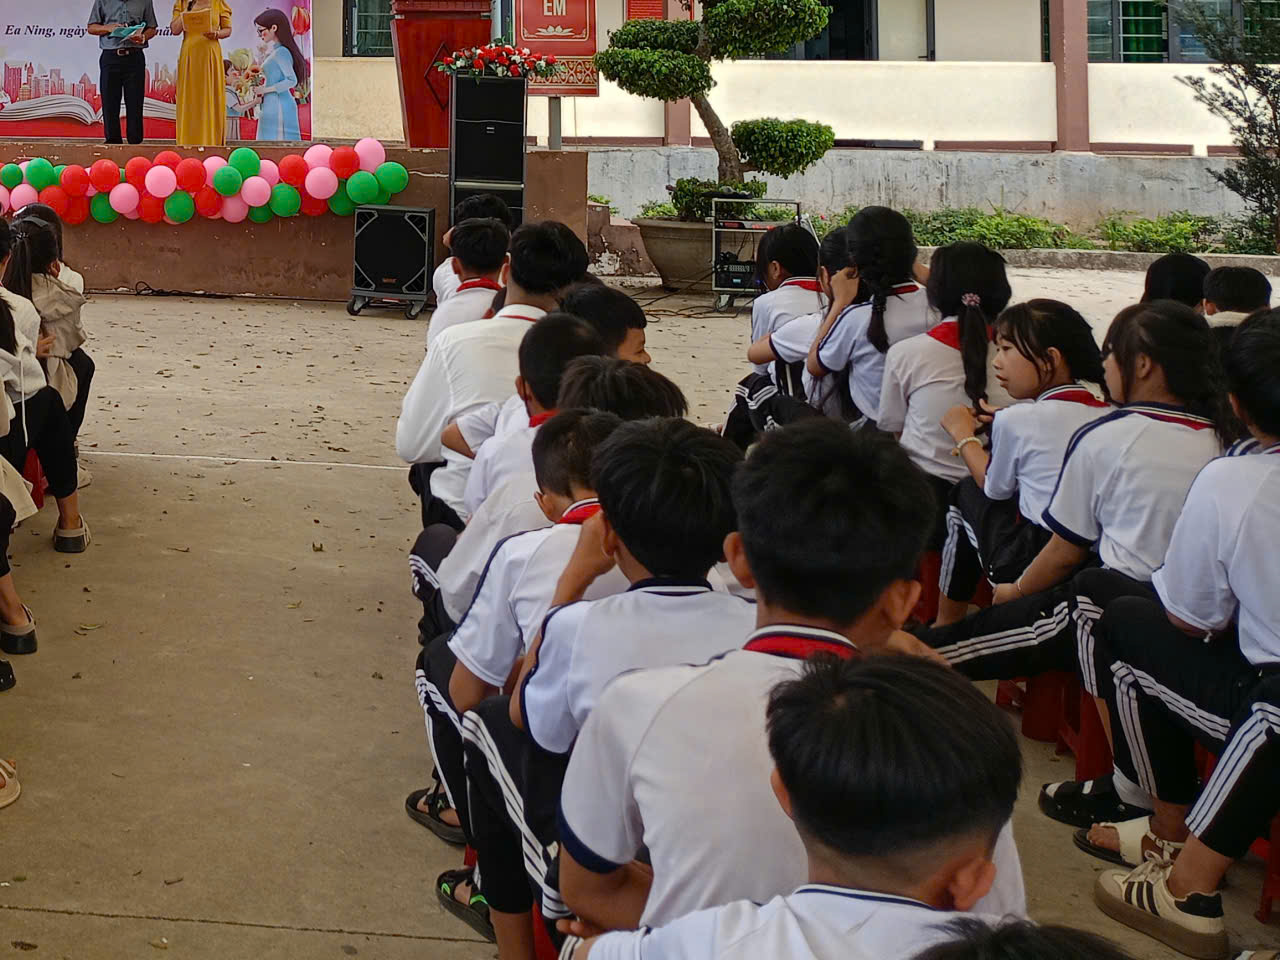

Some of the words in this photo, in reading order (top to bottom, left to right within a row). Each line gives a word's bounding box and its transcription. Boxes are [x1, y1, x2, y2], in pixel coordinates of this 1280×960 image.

[5, 25, 20, 35] Ea
[24, 25, 56, 38] Ning,
[59, 26, 87, 38] ngày
